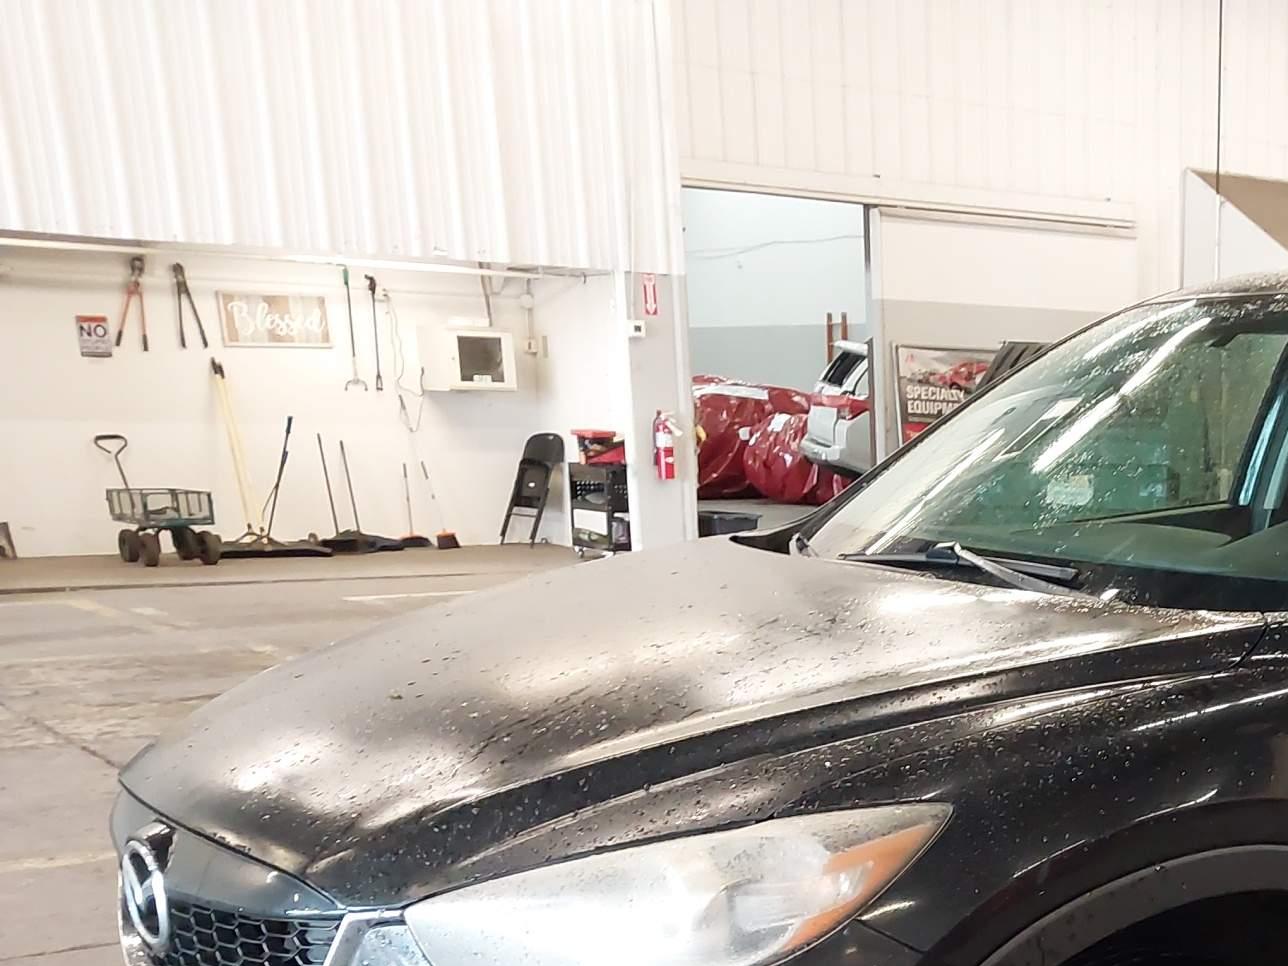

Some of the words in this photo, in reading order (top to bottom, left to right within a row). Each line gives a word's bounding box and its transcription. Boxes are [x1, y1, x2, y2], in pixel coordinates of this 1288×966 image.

[227, 300, 326, 336] Blessed
[79, 324, 107, 338] NO
[906, 385, 965, 401] SPECIALTY
